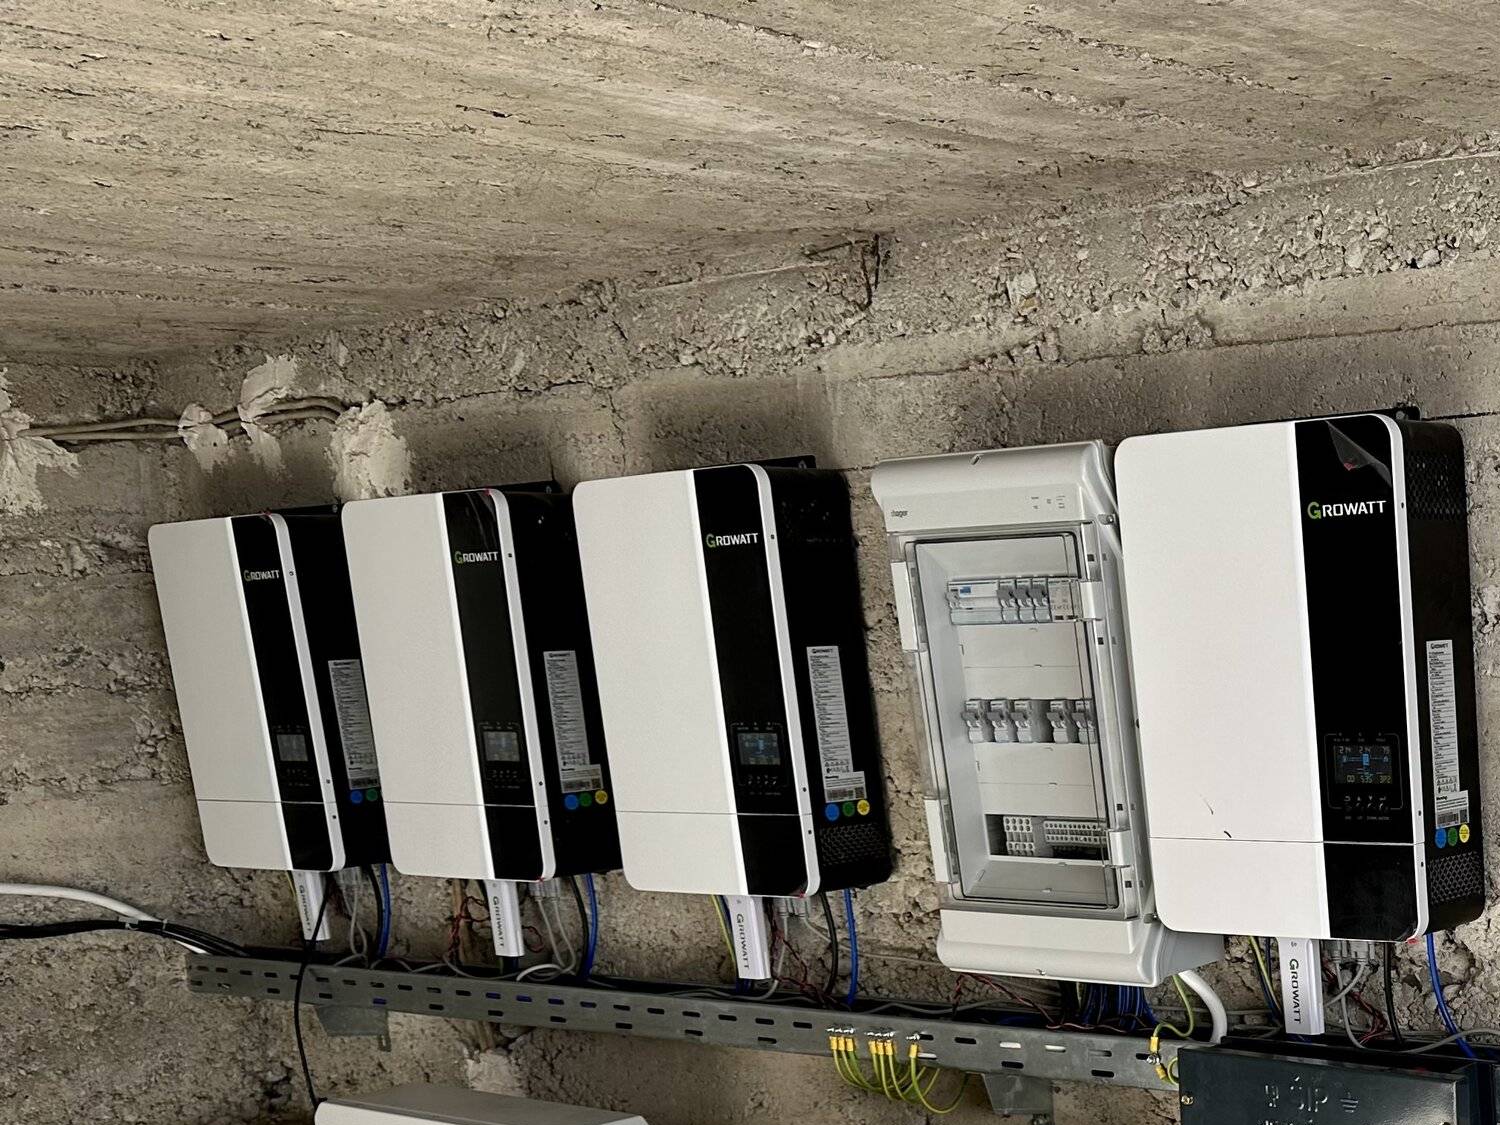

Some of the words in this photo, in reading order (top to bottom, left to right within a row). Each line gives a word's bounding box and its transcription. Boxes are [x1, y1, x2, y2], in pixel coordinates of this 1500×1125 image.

[1307, 500, 1387, 520] GROWATT
[705, 532, 759, 548] GROWATT
[454, 550, 499, 564] GROWATT
[243, 569, 280, 582] GROWATT
[736, 913, 750, 969] GROWATT
[1289, 958, 1301, 1025] GROWATT
